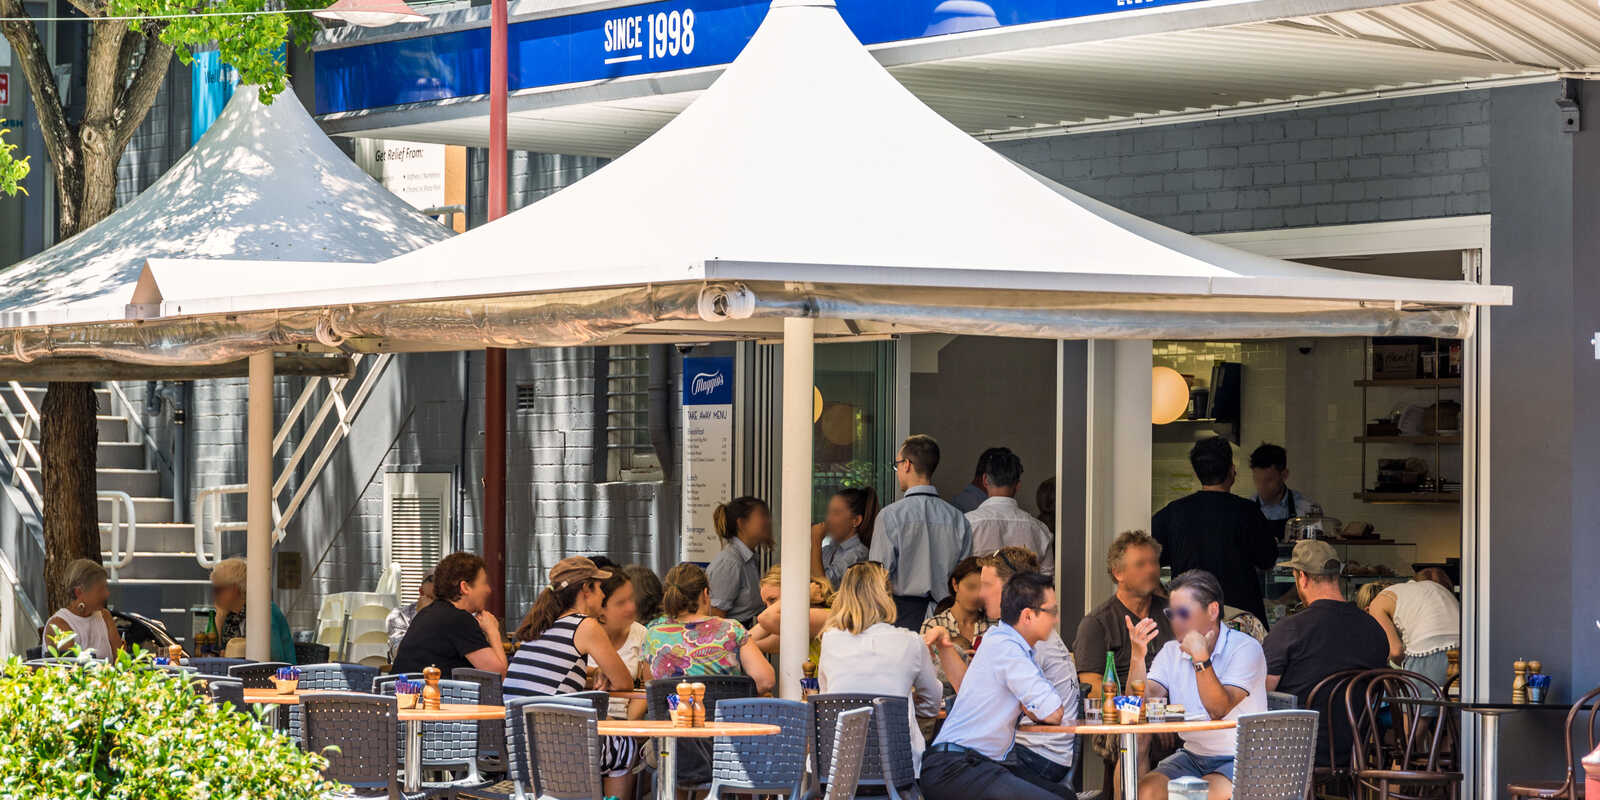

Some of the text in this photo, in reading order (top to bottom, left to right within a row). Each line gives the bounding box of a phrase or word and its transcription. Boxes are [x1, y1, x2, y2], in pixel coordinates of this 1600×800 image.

[604, 8, 695, 59] SINCE 1998
[375, 147, 424, 162] Get Relief From:
[687, 409, 728, 420] TAKE AWAY MENU
